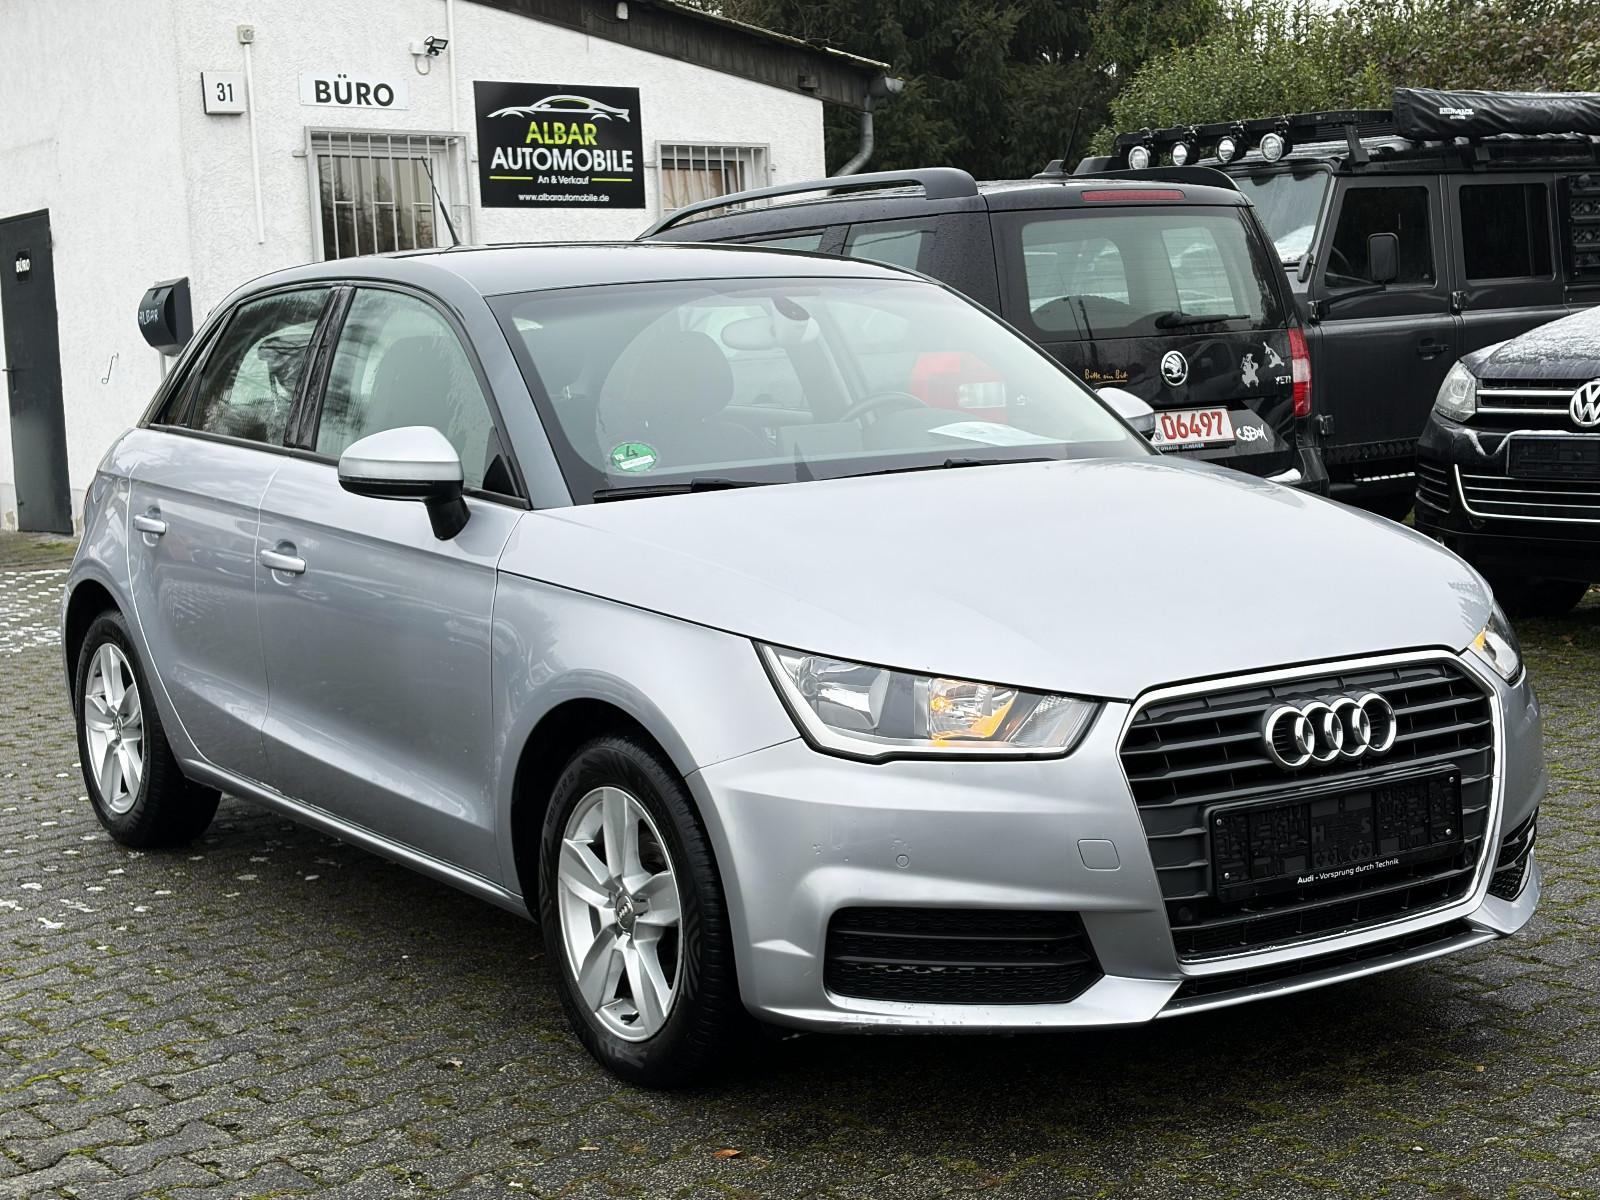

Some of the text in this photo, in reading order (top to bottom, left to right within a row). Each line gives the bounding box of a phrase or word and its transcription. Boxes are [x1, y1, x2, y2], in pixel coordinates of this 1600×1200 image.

[216, 82, 234, 102] 31
[314, 73, 395, 107] BÜRO
[525, 121, 598, 145] ALBAR
[490, 146, 634, 172] AUTOMOBILE
[537, 175, 590, 185] An & Verkauf
[518, 192, 610, 202] www.albarautomobile.de
[15, 258, 31, 273] BÜRO
[139, 308, 159, 325] ALBAR
[1161, 411, 1223, 440] 06497
[625, 445, 639, 457] 4
[1297, 874, 1314, 884] Audi
[1319, 868, 1354, 880] Vorsprung
[1355, 863, 1375, 873] durch
[1375, 857, 1400, 868] Technik
